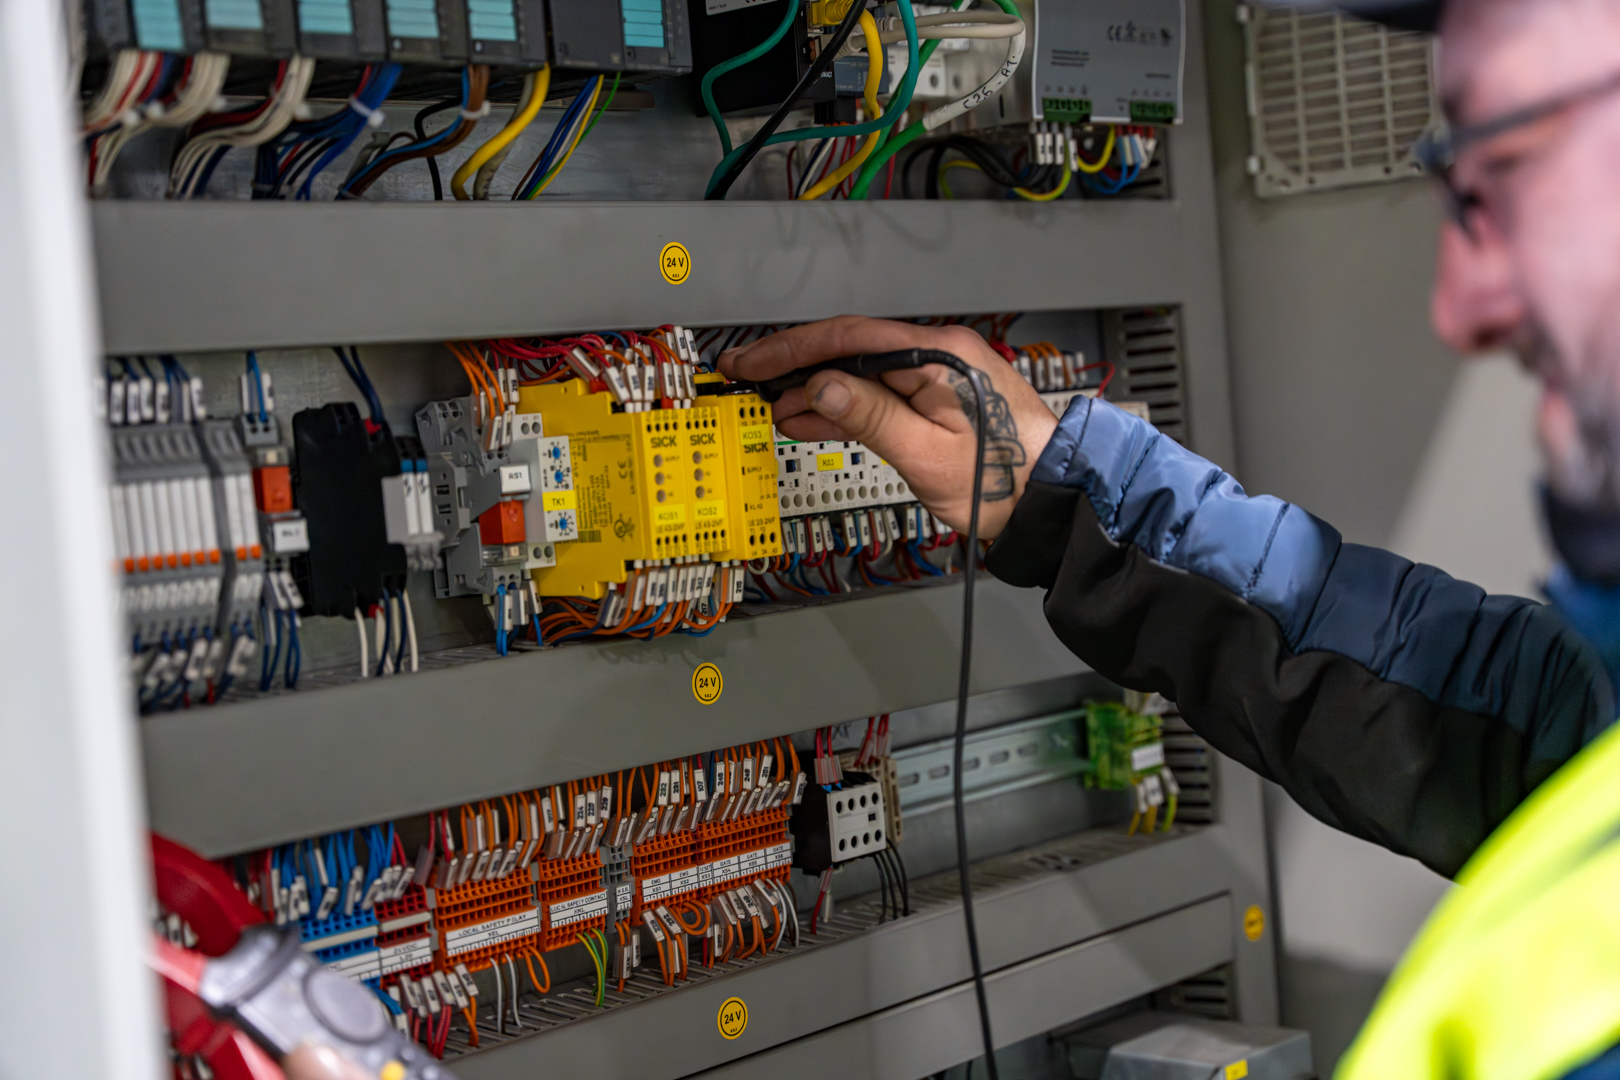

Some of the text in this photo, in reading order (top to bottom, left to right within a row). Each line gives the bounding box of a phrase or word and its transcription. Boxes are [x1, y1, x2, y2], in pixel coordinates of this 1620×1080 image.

[667, 257, 684, 267] 24 V
[650, 435, 677, 448] SICK
[690, 433, 716, 446] SICK
[744, 442, 768, 453] SICK
[551, 498, 565, 506] TK1
[699, 677, 716, 688] 24 V
[585, 893, 606, 903] CONTACT
[458, 927, 479, 936] LOCAL
[481, 921, 505, 930] SAFETY
[725, 1010, 741, 1024] 24 V
